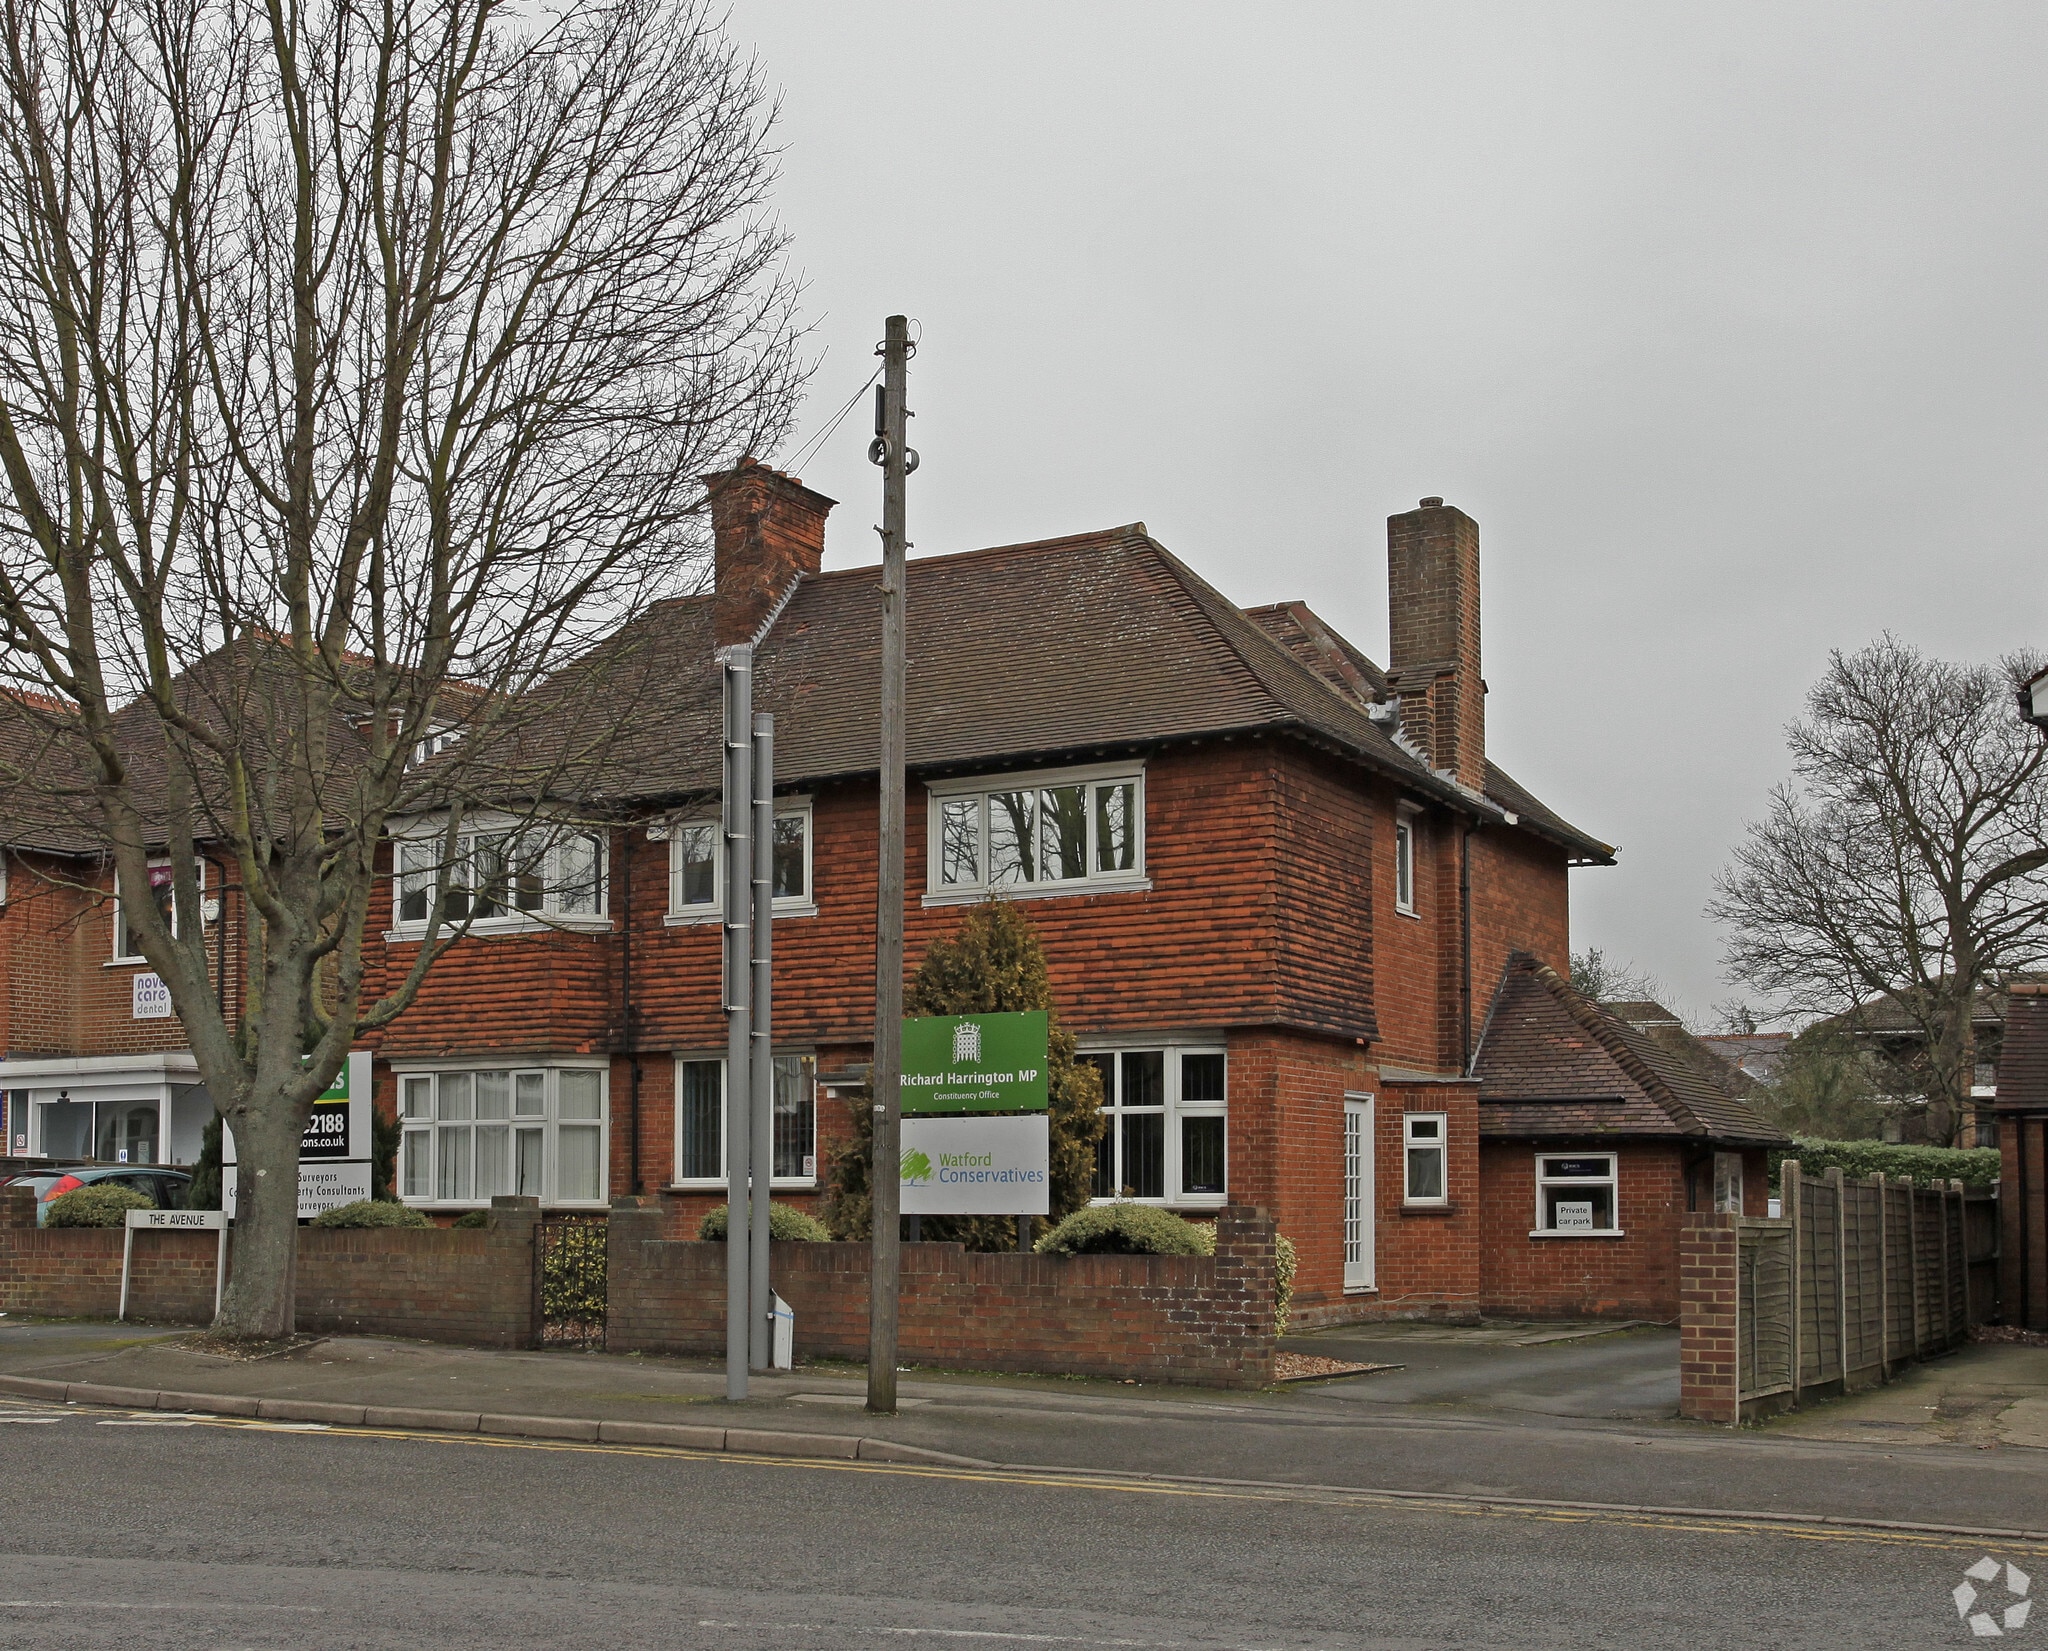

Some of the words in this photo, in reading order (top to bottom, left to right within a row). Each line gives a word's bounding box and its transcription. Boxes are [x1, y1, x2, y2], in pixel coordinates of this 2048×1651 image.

[138, 990, 166, 1002] care
[138, 1003, 166, 1014] dental
[900, 1072, 944, 1086] Richard
[947, 1071, 1013, 1086] Harrington
[1018, 1070, 1037, 1082] MP
[933, 1091, 978, 1101] Constituency
[978, 1090, 1000, 1099] Office
[303, 1113, 345, 1134] 2188
[300, 1134, 345, 1147] ons.co.uk
[939, 1151, 992, 1167] Watford
[298, 1171, 337, 1184] Surveyors
[939, 1167, 1044, 1183] Conservatives
[316, 1184, 365, 1196] Consultants
[298, 1201, 334, 1213] urveyors
[149, 1214, 165, 1225] THE
[169, 1214, 205, 1226] AVENUE
[1573, 1217, 1591, 1226] park
